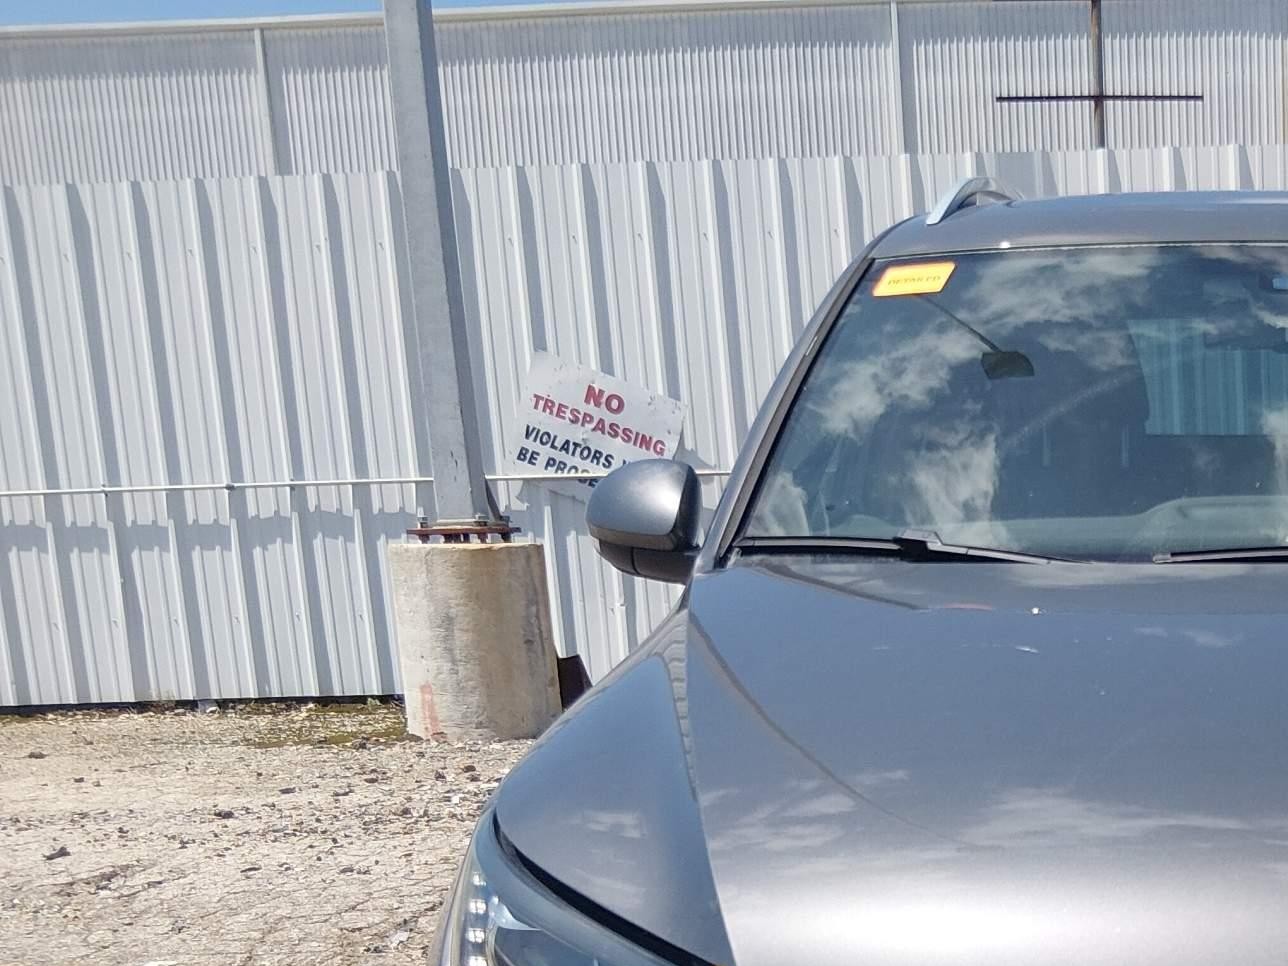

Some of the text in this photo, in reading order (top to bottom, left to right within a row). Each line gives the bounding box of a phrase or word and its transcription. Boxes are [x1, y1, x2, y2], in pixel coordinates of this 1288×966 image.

[583, 383, 626, 415] NO
[532, 393, 667, 457] TRESPASSING
[516, 446, 541, 467] BE
[524, 424, 615, 470] VIOLATORS
